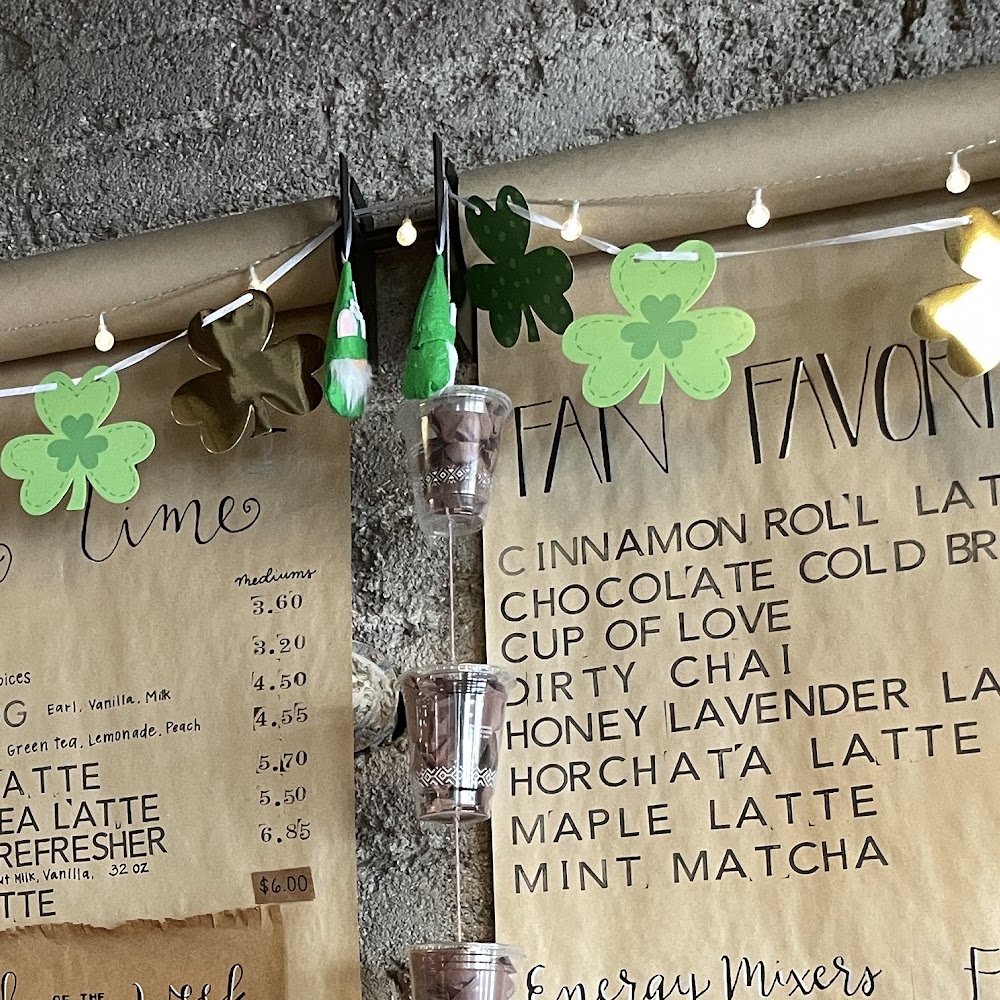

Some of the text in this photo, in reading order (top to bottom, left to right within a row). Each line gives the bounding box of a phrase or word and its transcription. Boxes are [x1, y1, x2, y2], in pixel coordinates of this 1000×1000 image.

[498, 494, 879, 576] CINNAMON ROLL
[235, 567, 317, 587] mediums
[500, 559, 775, 621] CHOCOLATE
[251, 593, 303, 615] 3.60
[253, 634, 305, 656] 3.20
[253, 672, 307, 692] 4.50
[254, 704, 308, 729] 4.55
[506, 677, 909, 750] HONEY LAVENDER
[7, 740, 47, 758] Green
[166, 720, 200, 736] Peach
[511, 721, 980, 796] HORCHATA LATTE
[259, 785, 306, 806] 5.50
[54, 794, 160, 828] LATTE
[512, 784, 877, 845] MAPLE LATTE
[260, 821, 311, 842] 6.85
[673, 836, 888, 883] MATCHA
[259, 873, 307, 895] $6.00
